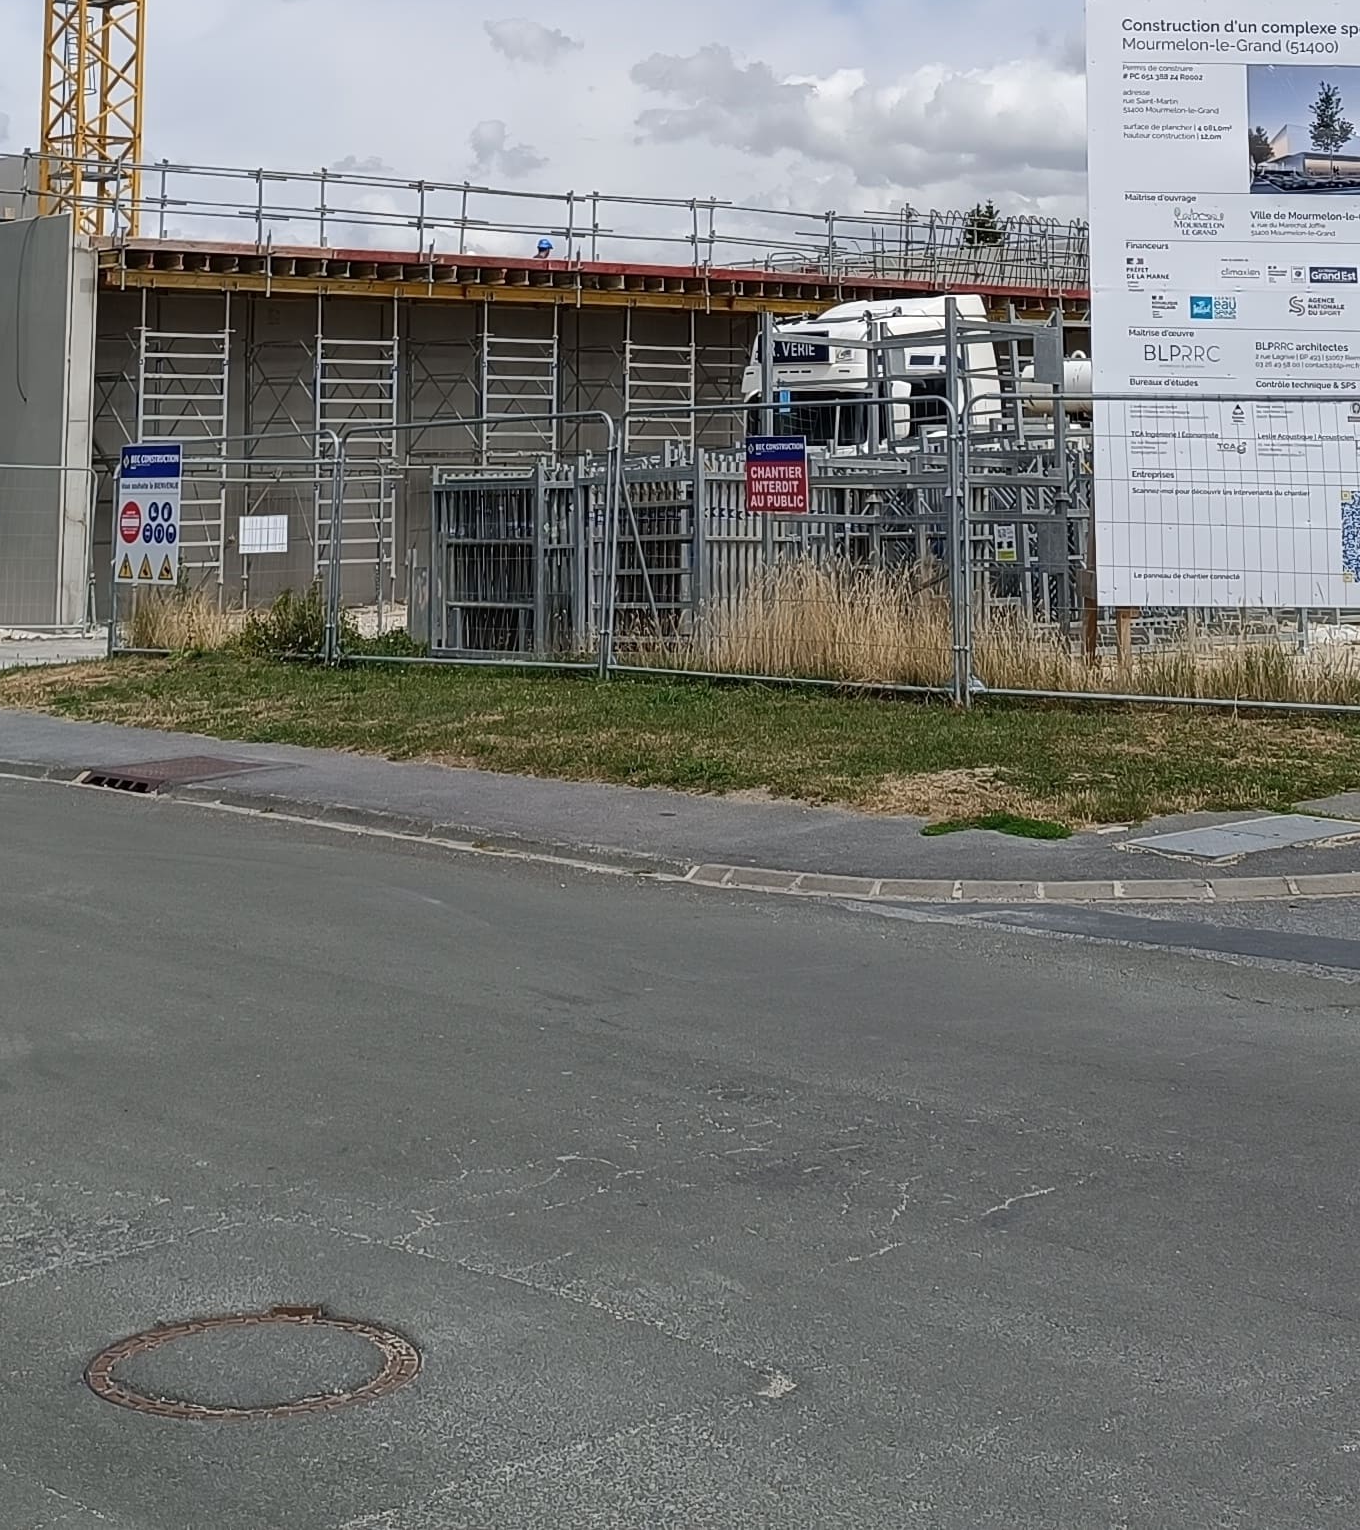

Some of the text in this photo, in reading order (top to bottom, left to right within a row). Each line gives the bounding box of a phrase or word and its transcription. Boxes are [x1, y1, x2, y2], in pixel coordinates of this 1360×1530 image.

[1122, 19, 1220, 32] Construction
[1224, 20, 1257, 33] d'un
[1262, 22, 1337, 37] complexe
[1122, 38, 1339, 54] Mourmelon-le-Grand (51400)
[1136, 97, 1178, 105] Saint-Martin
[1161, 124, 1192, 132] plancher
[1157, 194, 1196, 203] d'ouvrage
[1250, 211, 1272, 220] Ville
[1274, 212, 1286, 220] de
[1311, 271, 1356, 281] Grand Est
[1214, 300, 1236, 309] eau
[1129, 329, 1194, 337] Maîtrise d'œuvre
[782, 342, 816, 357] VERIE
[1255, 342, 1348, 351] BLPRRC architectes
[1130, 378, 1162, 386] Bureaux
[1256, 380, 1290, 388] Contrôle
[1292, 381, 1331, 390] technique
[131, 454, 179, 463] BEC CONSTRUCTION
[751, 466, 802, 478] CHANTIER
[1132, 470, 1175, 479] Entreprises
[752, 480, 799, 493] INTERDIT
[751, 495, 804, 507] AU PUBLIC
